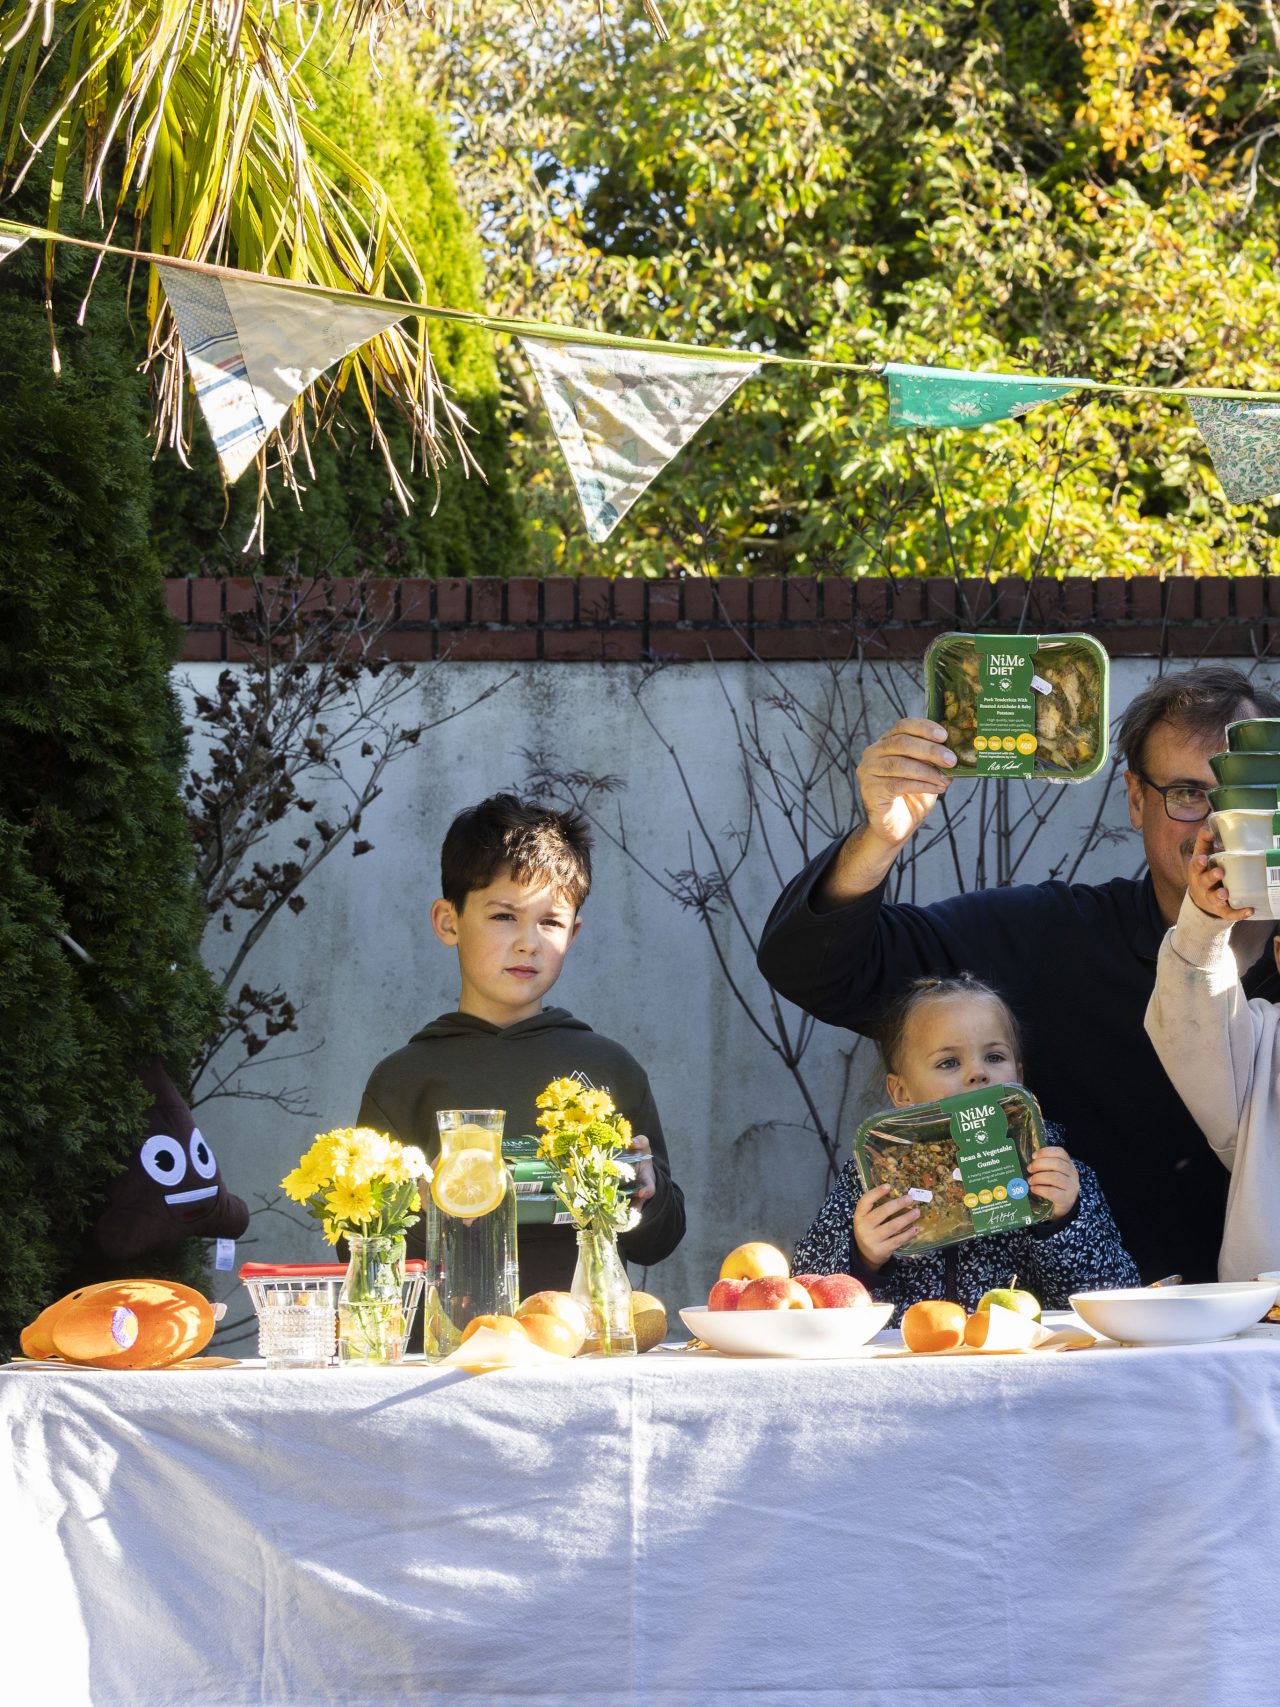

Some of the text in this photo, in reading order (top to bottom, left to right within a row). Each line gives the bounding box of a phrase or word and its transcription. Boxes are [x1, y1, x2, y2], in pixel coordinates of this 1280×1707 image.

[990, 654, 1026, 667] NiMe
[989, 666, 1015, 676] DIET
[959, 1104, 996, 1123] NiMe
[961, 1117, 987, 1132] DIET
[959, 1154, 976, 1163] Bean
[982, 1144, 1013, 1157] Vegetable
[977, 1158, 1001, 1169] Gumbo
[1011, 1186, 1025, 1196] 300
